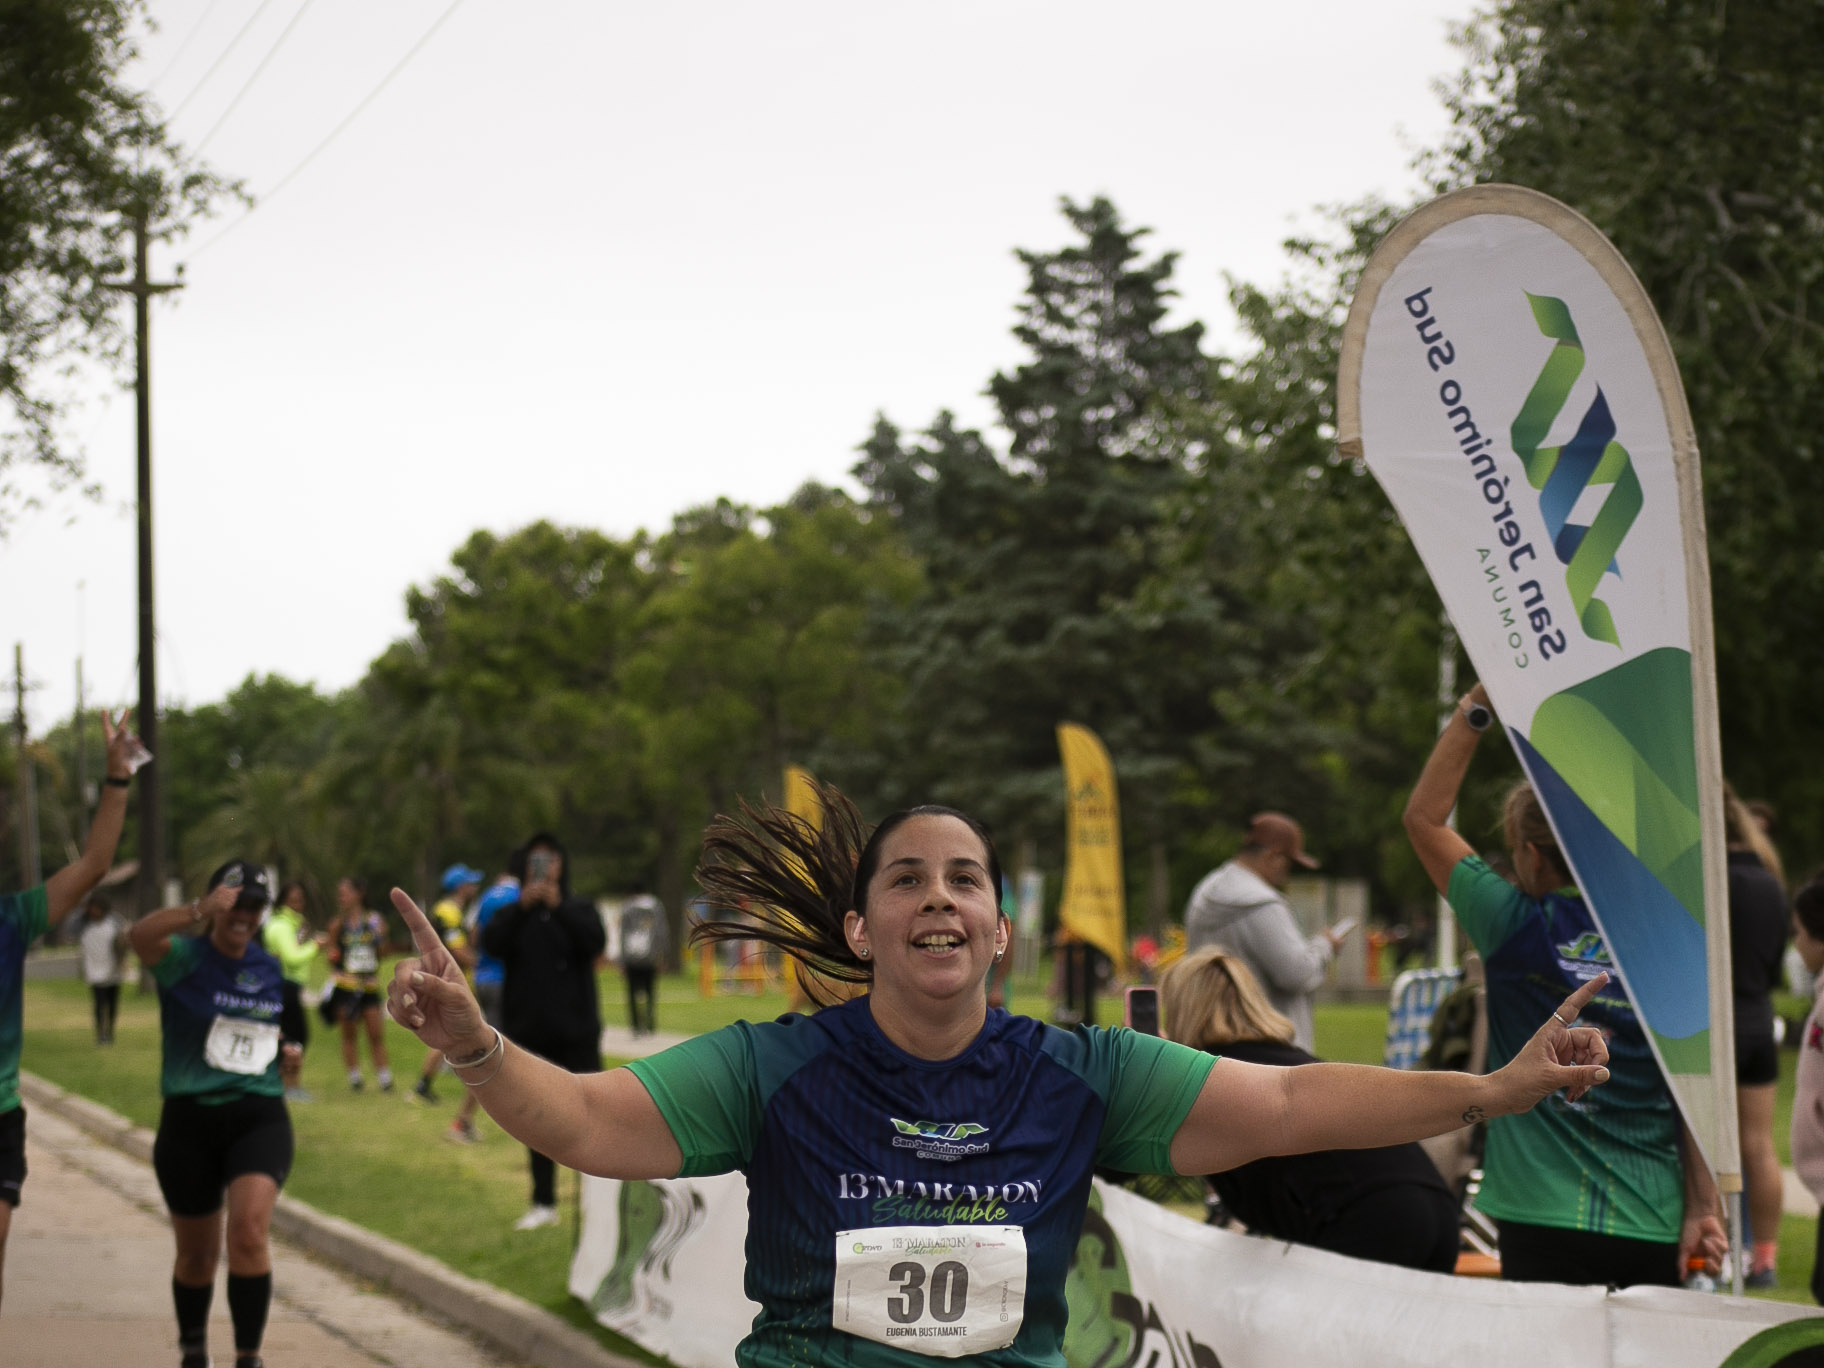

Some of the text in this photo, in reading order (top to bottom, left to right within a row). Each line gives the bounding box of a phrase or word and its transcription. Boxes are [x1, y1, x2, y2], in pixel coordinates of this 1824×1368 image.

[892, 1136, 990, 1154] San Jerónimo Sud
[872, 1193, 1009, 1225] Saludable
[886, 1260, 968, 1324] 30
[886, 1326, 968, 1337] EUGENIA BUSTAMANTE
